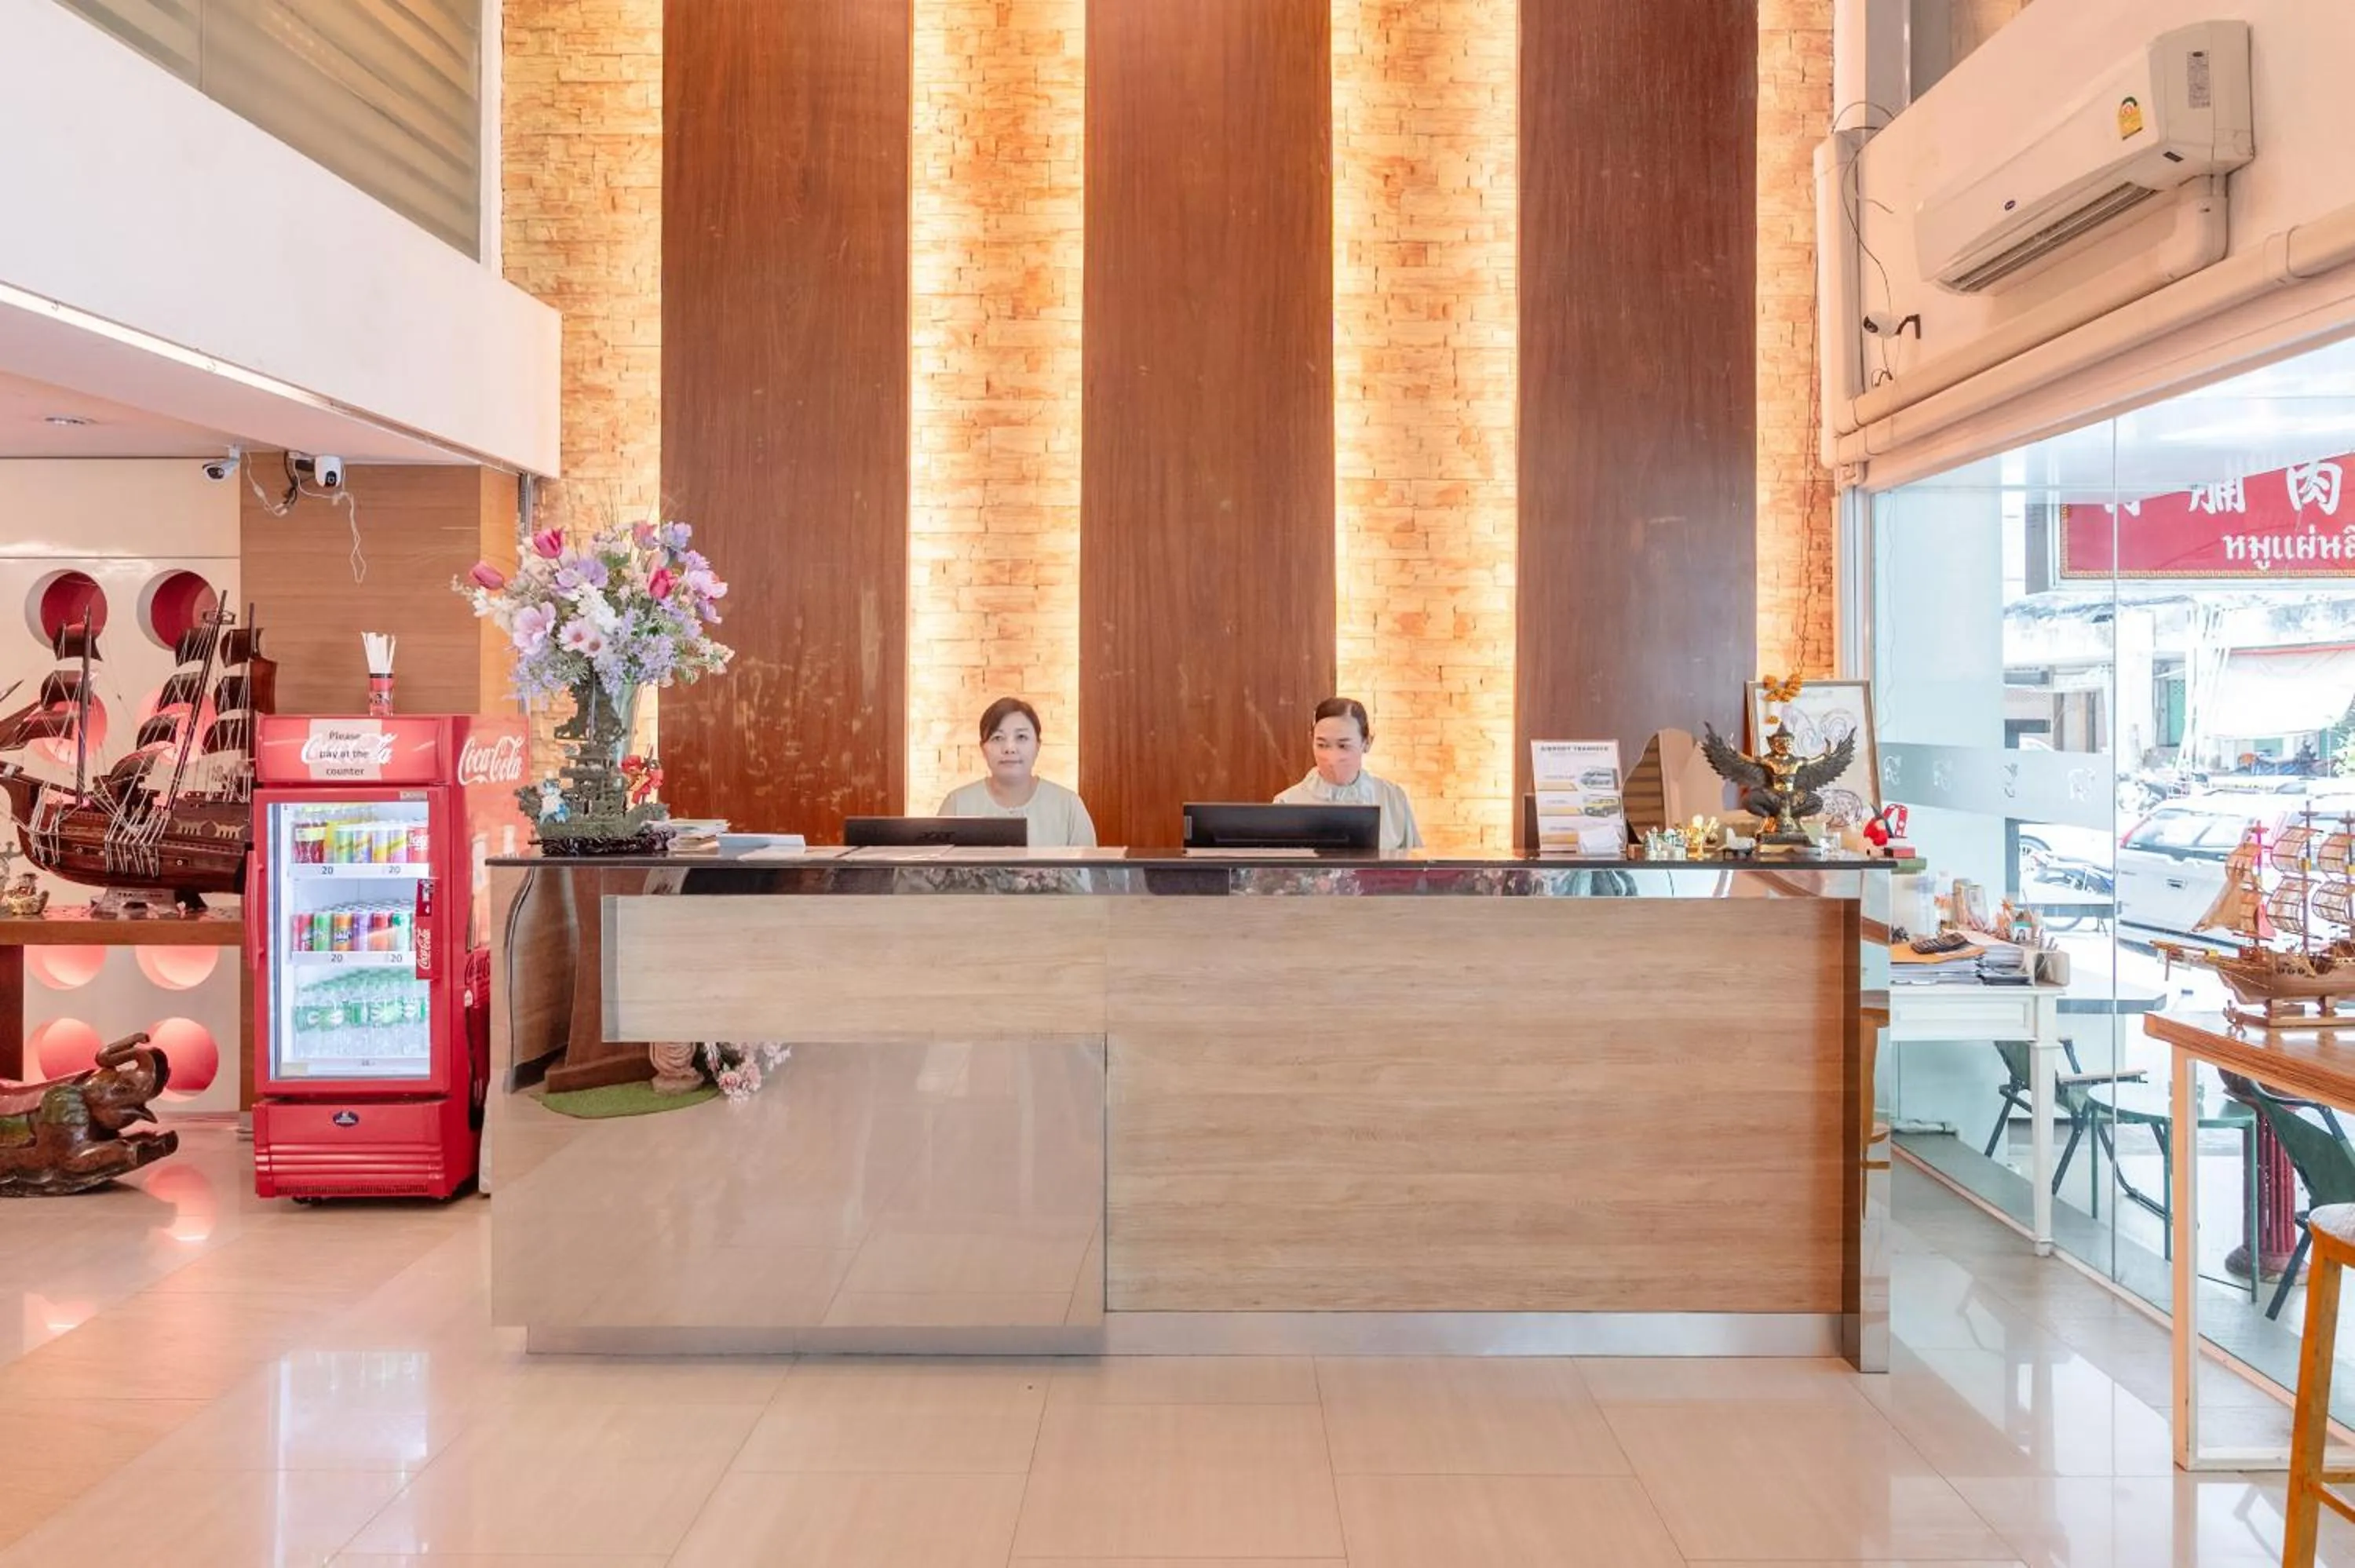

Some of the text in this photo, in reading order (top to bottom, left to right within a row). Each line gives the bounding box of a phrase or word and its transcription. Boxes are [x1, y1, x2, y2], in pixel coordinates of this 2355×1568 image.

[329, 731, 361, 740] Please
[319, 749, 370, 759] pay at the
[458, 735, 525, 786] Coca-Cola
[326, 768, 365, 776] counter
[321, 866, 334, 875] 20
[389, 865, 401, 874] 20
[330, 954, 343, 963] 20
[391, 954, 403, 963] 20
